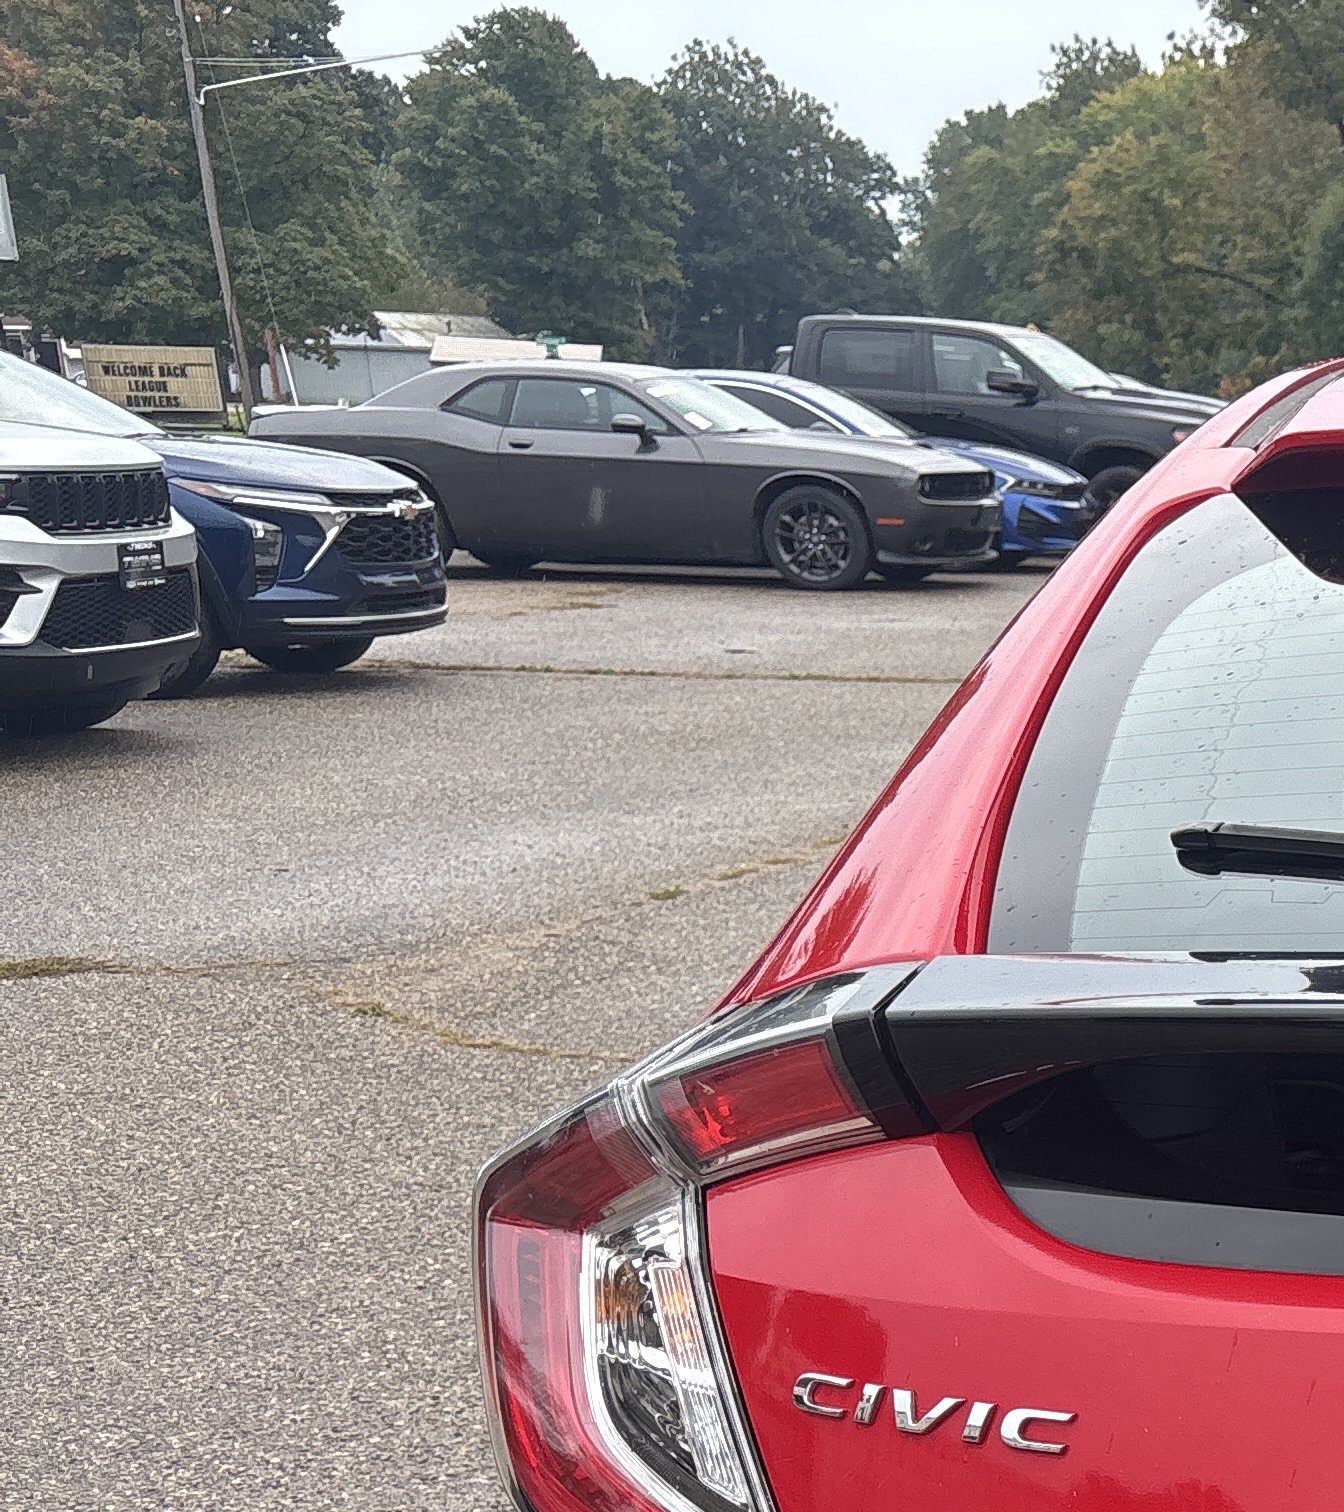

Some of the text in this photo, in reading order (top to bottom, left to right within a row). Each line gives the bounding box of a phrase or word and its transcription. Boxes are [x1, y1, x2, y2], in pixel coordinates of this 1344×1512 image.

[101, 364, 188, 378] WELCOME BACK
[128, 380, 169, 393] LEAGUE
[126, 394, 181, 408] BOWLERS
[791, 1372, 1079, 1455] CIVIC
